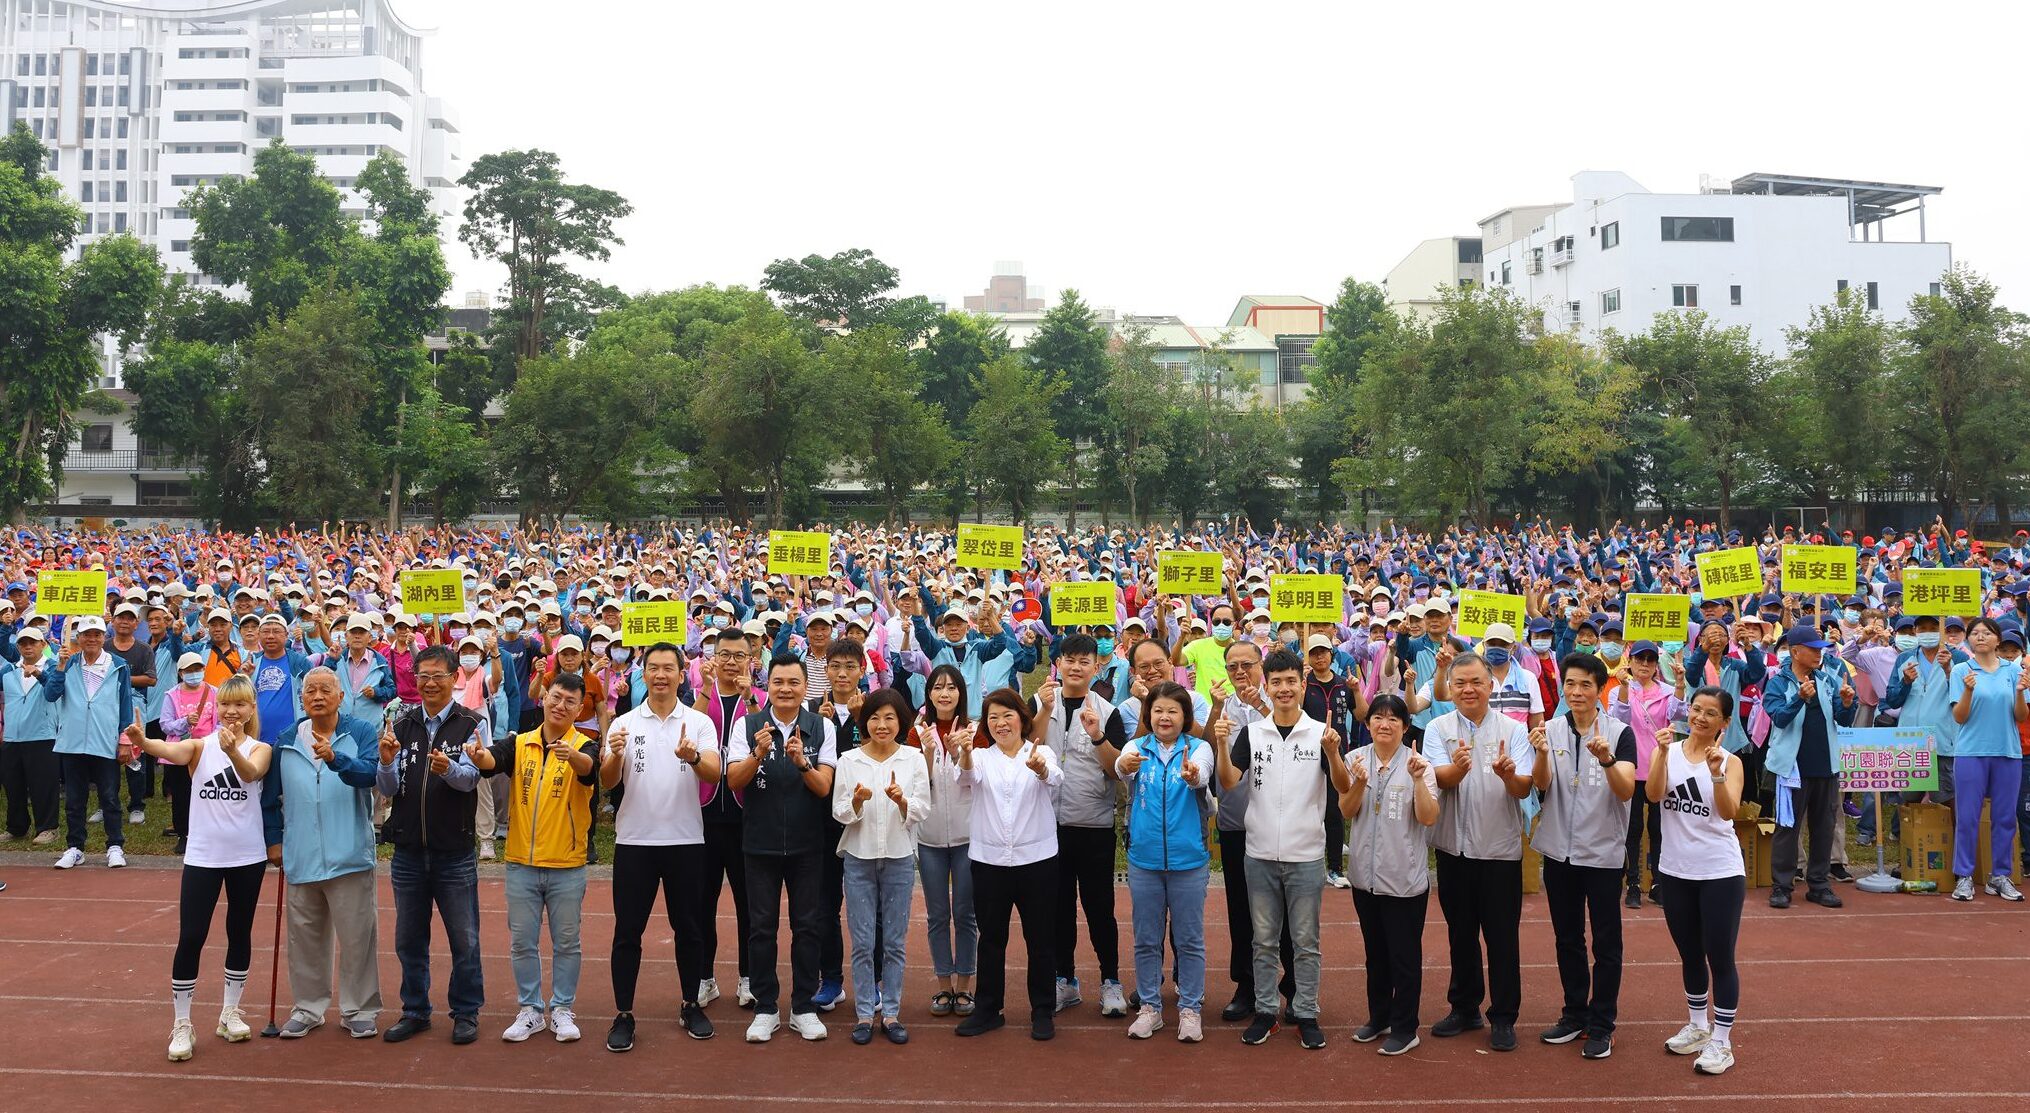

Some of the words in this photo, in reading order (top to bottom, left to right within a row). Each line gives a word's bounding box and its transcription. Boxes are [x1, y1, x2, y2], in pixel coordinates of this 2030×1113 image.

[773, 545, 821, 564] 垂楊里
[962, 539, 1015, 558] 翠岱里
[1163, 565, 1214, 583] 獅子里
[1788, 561, 1847, 581] 福安里
[42, 585, 97, 603] 車店里
[407, 584, 457, 602] 湖內里
[1276, 590, 1334, 609] 導明里
[1909, 584, 1972, 603] 港坪里
[1056, 596, 1108, 614] 美源里
[627, 616, 678, 634] 福民里
[1463, 606, 1516, 628] 致遠里
[1630, 609, 1681, 629] 新西里
[551, 759, 564, 799] 大碩士
[199, 787, 248, 801] adidas
[1663, 798, 1710, 817] adidas
